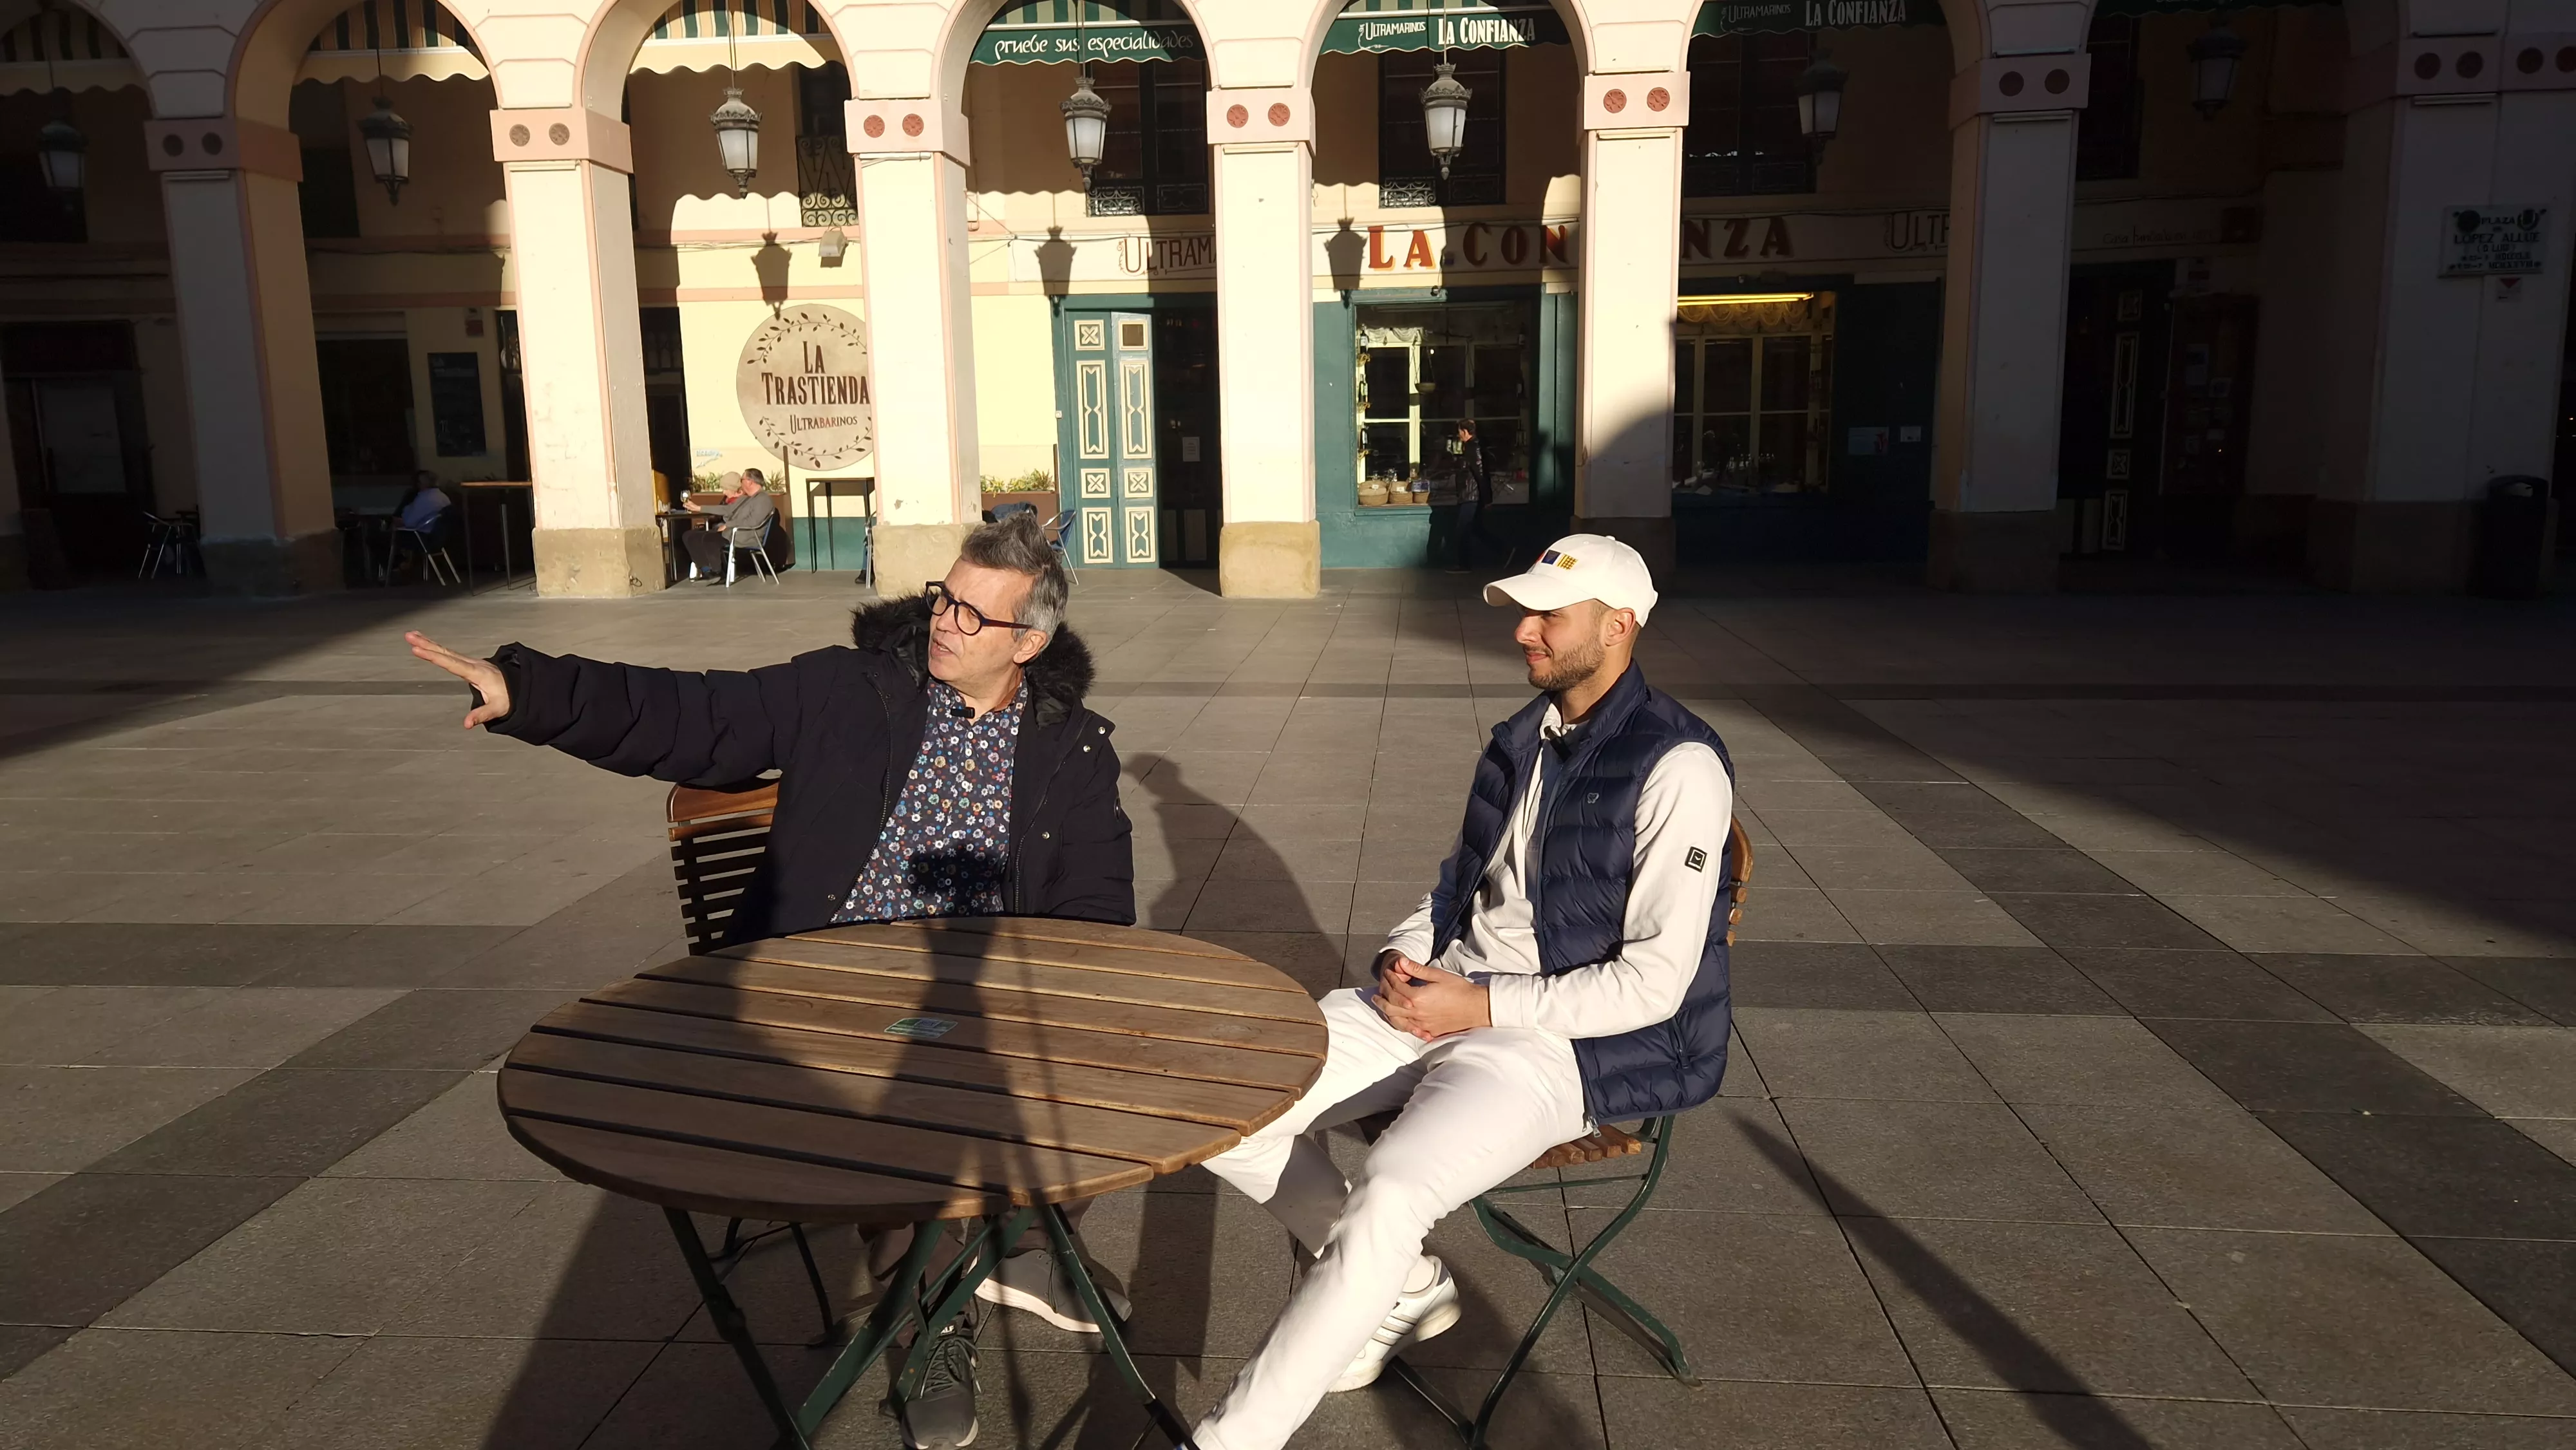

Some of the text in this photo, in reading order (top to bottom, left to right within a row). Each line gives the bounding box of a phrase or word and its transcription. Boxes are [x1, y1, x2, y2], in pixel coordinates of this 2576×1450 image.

[1728, 4, 1792, 23] ULTRAMARINOS
[1805, 0, 1907, 26] LA CONFIANZA
[1365, 21, 1426, 41] ULTRAMARINOS
[1437, 17, 1535, 45] LA CONFIANZA
[994, 30, 1194, 61] pruebe sus especialidades
[2481, 216, 2515, 225] PLAZA
[1124, 237, 1217, 273] ULTRAM
[1367, 225, 1437, 272] LA
[803, 341, 826, 374] LA
[761, 372, 870, 406] TRASTIENDA
[790, 415, 858, 435] ULTRABARINOS
